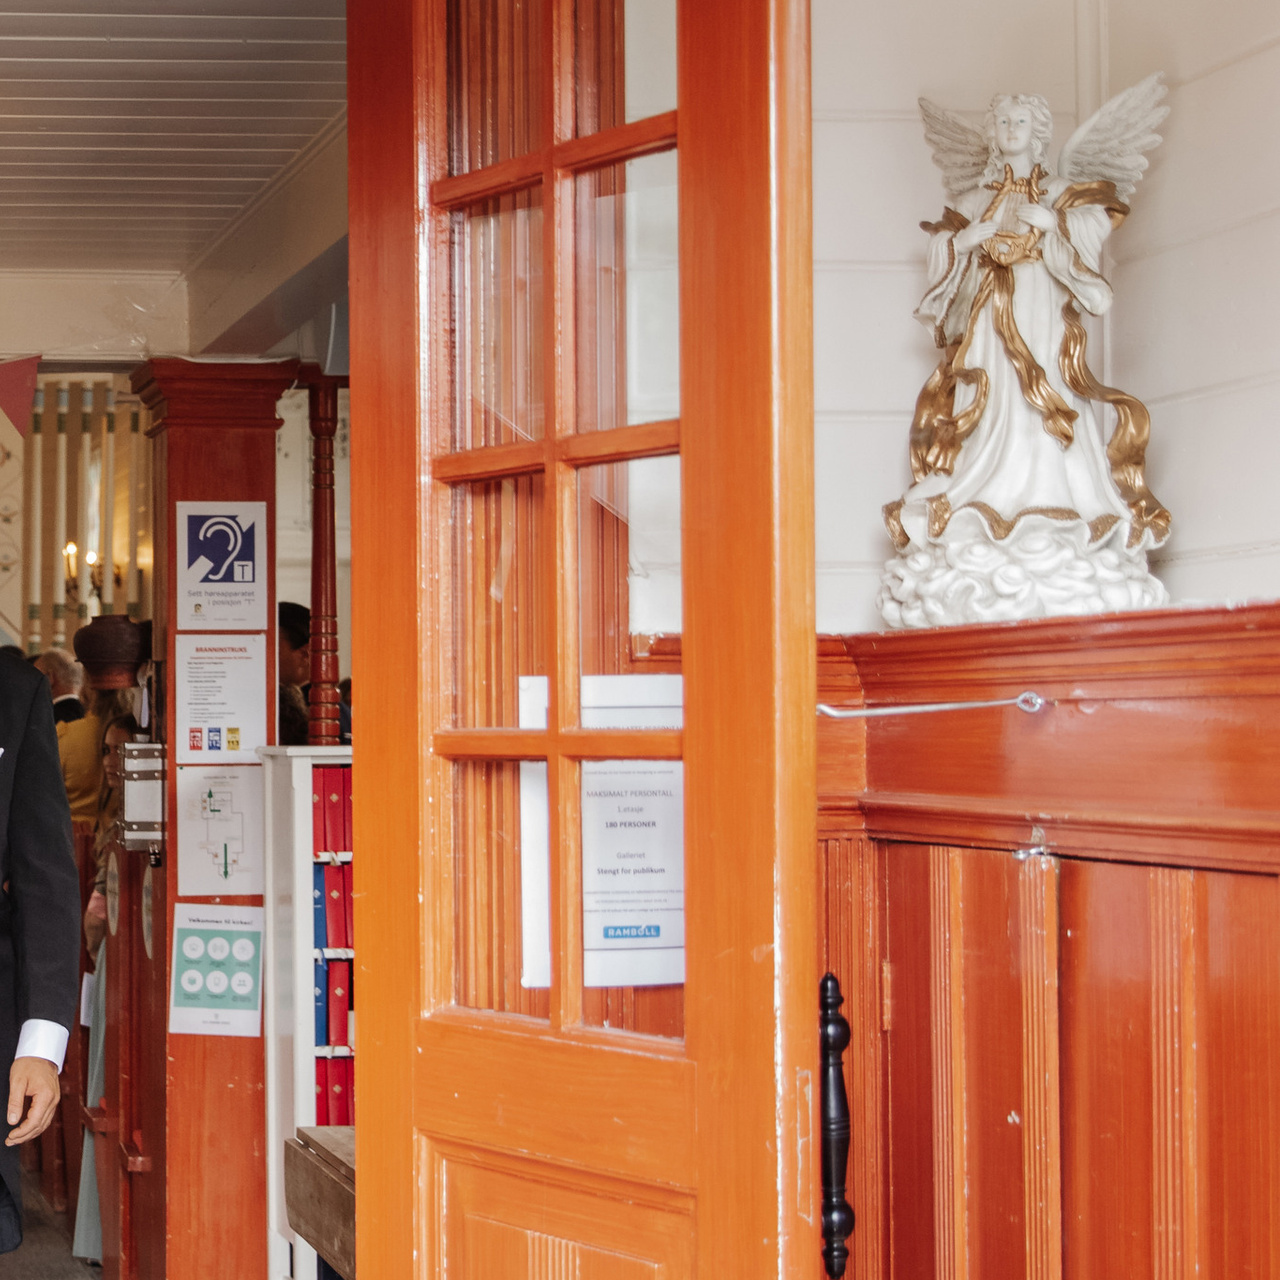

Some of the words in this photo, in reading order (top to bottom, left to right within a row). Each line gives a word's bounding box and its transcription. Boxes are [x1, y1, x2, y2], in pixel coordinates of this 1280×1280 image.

[237, 564, 249, 580] T
[597, 868, 619, 876] Stengt
[633, 867, 665, 875] publikum
